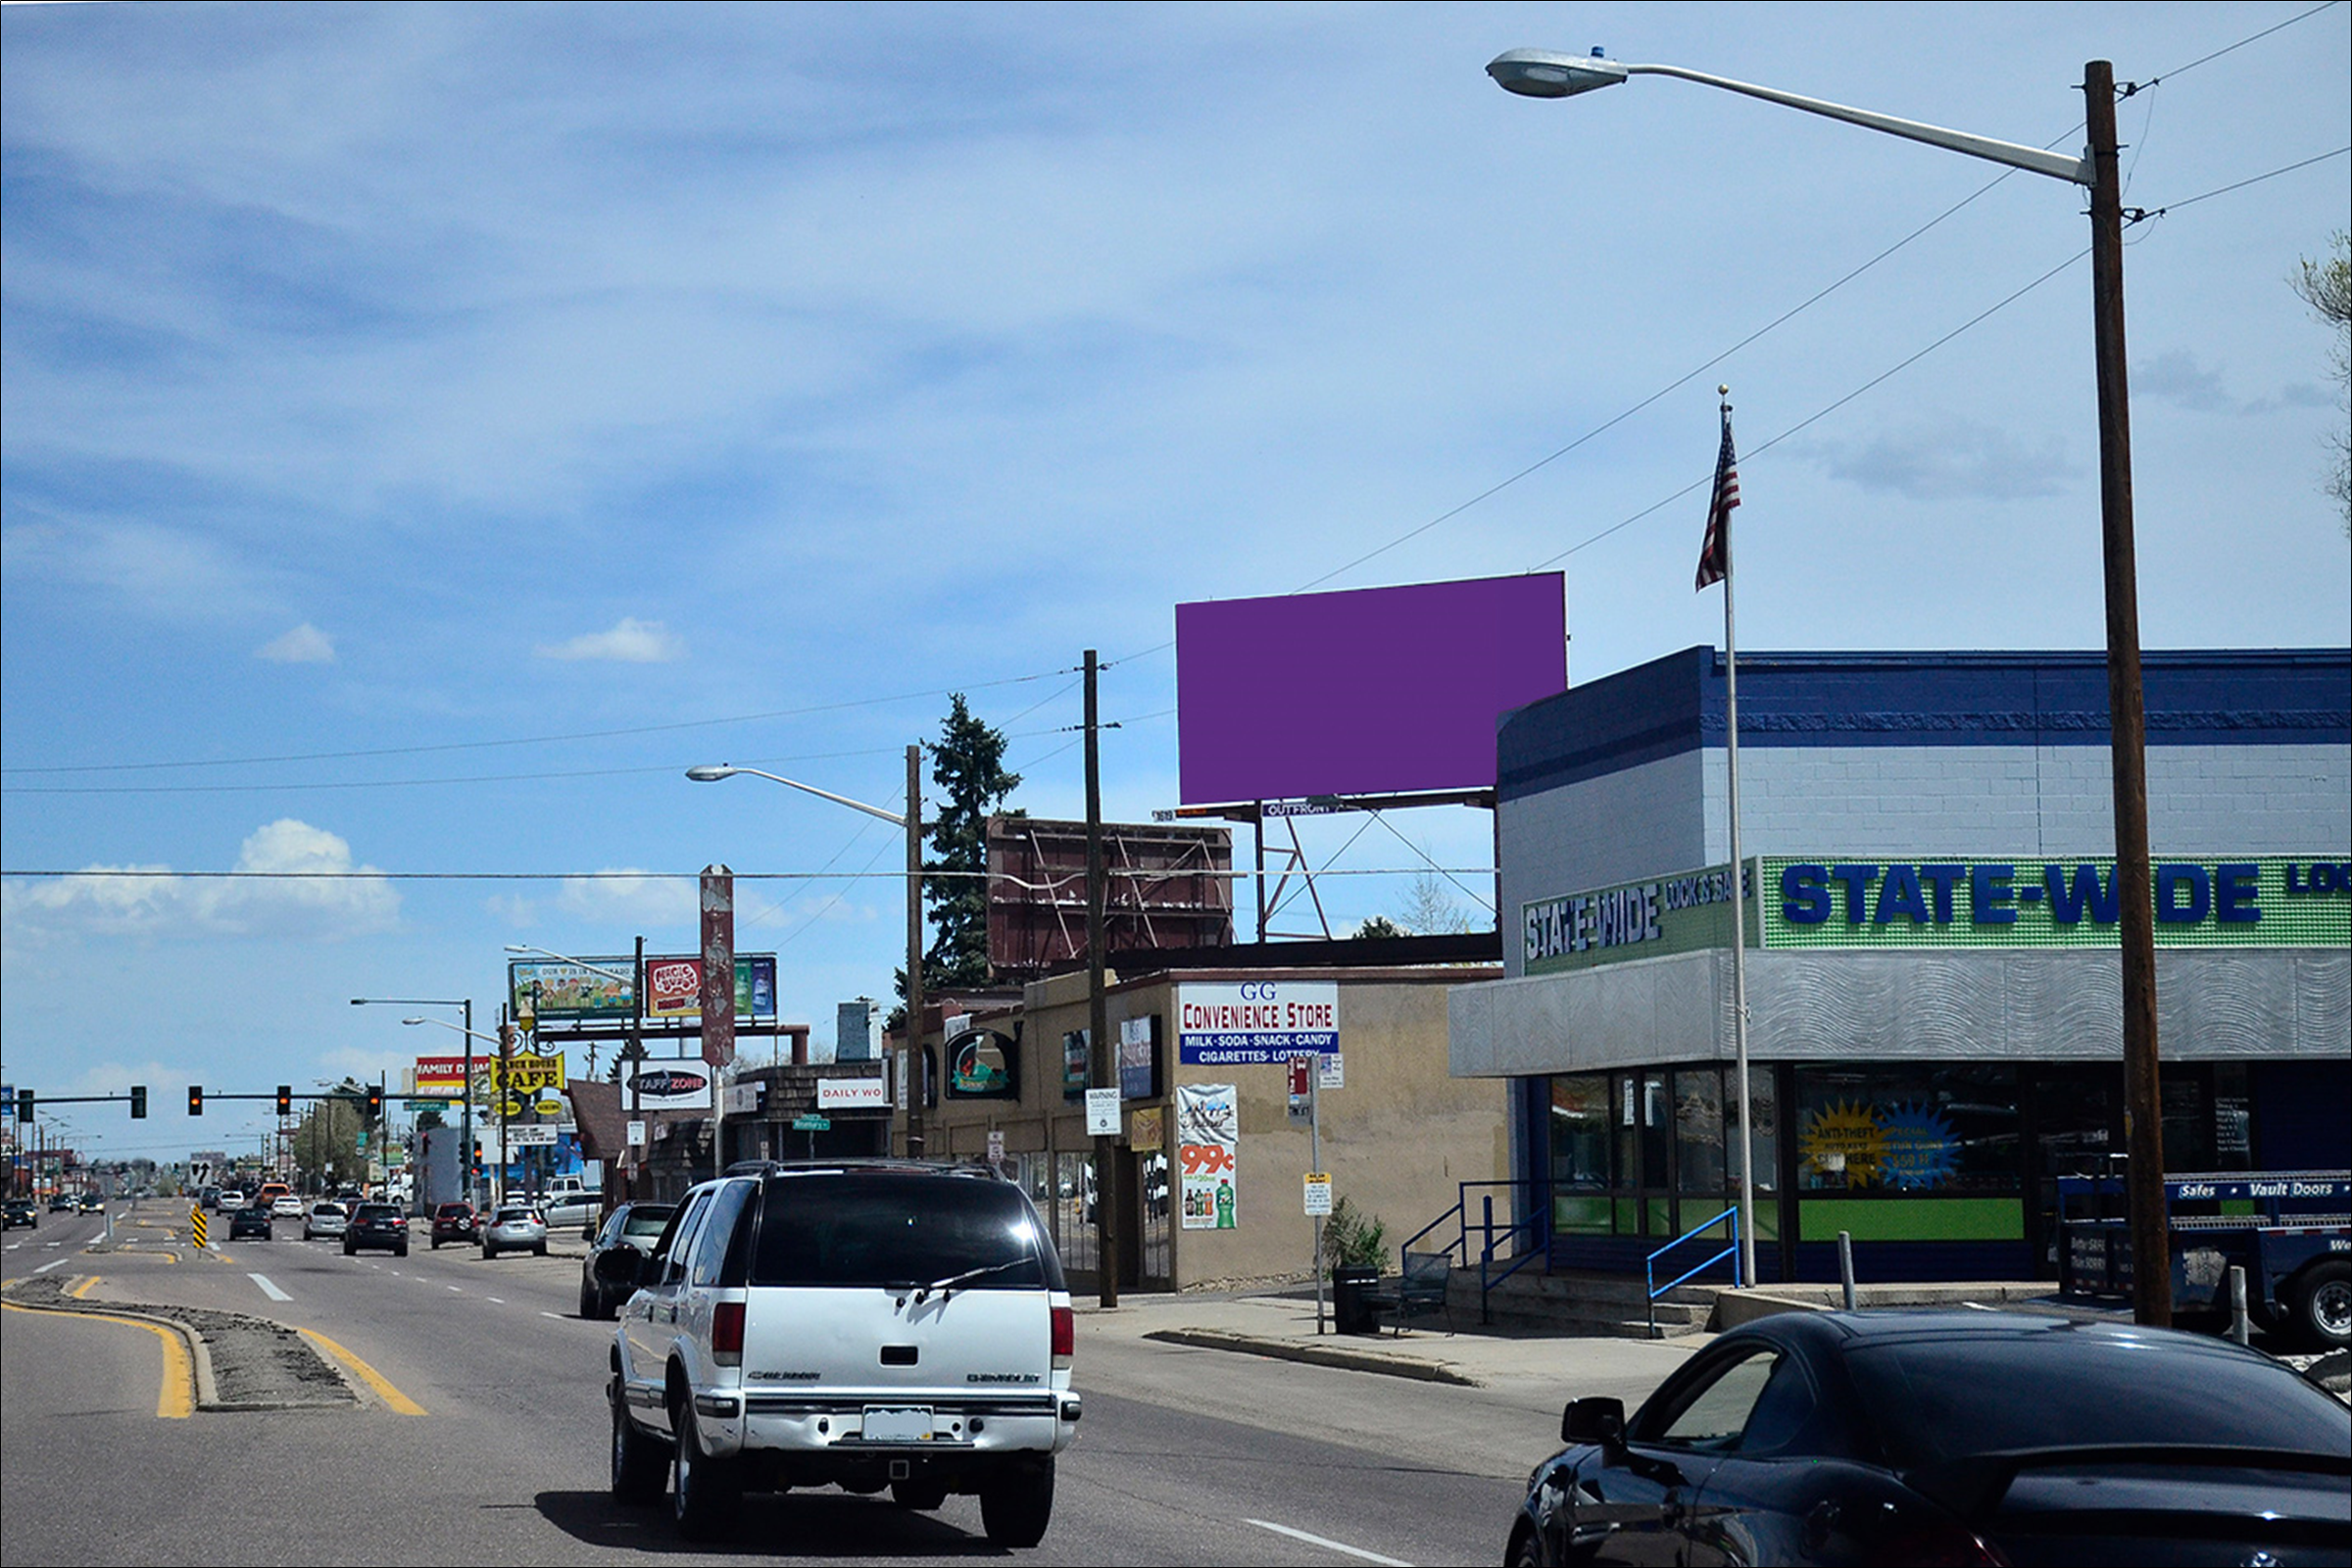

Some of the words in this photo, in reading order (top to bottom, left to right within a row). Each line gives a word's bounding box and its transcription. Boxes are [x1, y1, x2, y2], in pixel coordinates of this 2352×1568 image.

[1782, 863, 2262, 925] STATE-WDE
[1526, 884, 1661, 959] STATE-WIDE
[1666, 877, 1697, 909] LOCK
[1715, 868, 1750, 902] SAE
[1241, 982, 1276, 1001] GG
[1184, 1004, 1280, 1029] CONVENIENCE
[1287, 1003, 1333, 1028] STORE
[1185, 1036, 1213, 1047] MILK
[1218, 1035, 1248, 1047] SODA
[1252, 1035, 1291, 1047] SNACK
[1298, 1034, 1333, 1046] CANDY
[417, 1062, 453, 1074] FAMILY
[496, 1071, 558, 1088] CAFE
[670, 1078, 704, 1089] ZONE
[822, 1089, 858, 1099] DAILY
[1845, 1153, 1877, 1164] HERE
[2180, 1184, 2216, 1197] Safes
[2249, 1183, 2287, 1196] Vault
[2291, 1183, 2333, 1196] Doors
